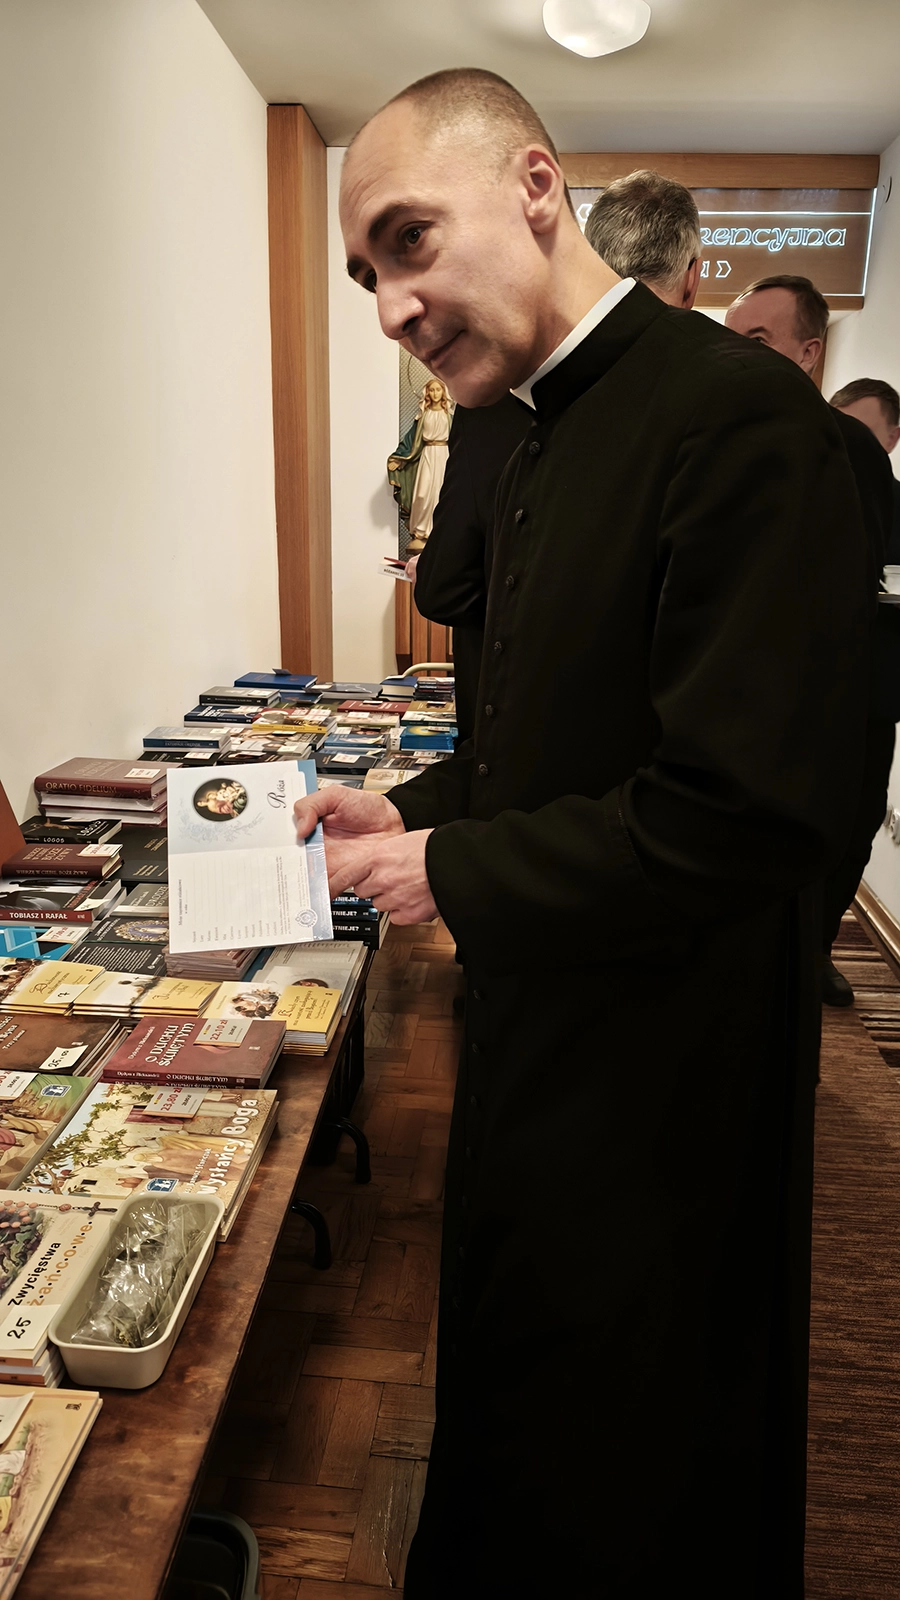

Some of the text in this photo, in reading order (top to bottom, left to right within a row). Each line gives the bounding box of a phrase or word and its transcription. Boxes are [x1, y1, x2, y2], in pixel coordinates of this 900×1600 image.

[700, 227, 847, 252] rencyjna
[45, 781, 77, 791] ORATIO
[78, 784, 118, 794] FIDELIUM
[267, 780, 286, 809] Róża
[149, 1025, 179, 1055] DUCHU
[156, 1022, 196, 1067] ŚWIĘTYM
[145, 1055, 158, 1063] O
[195, 1075, 228, 1083] ŚWIĘTYM
[197, 1099, 259, 1194] Wysłańcy Boga
[7, 1241, 62, 1307] Zwycięstwa
[6, 1316, 32, 1340] 25
